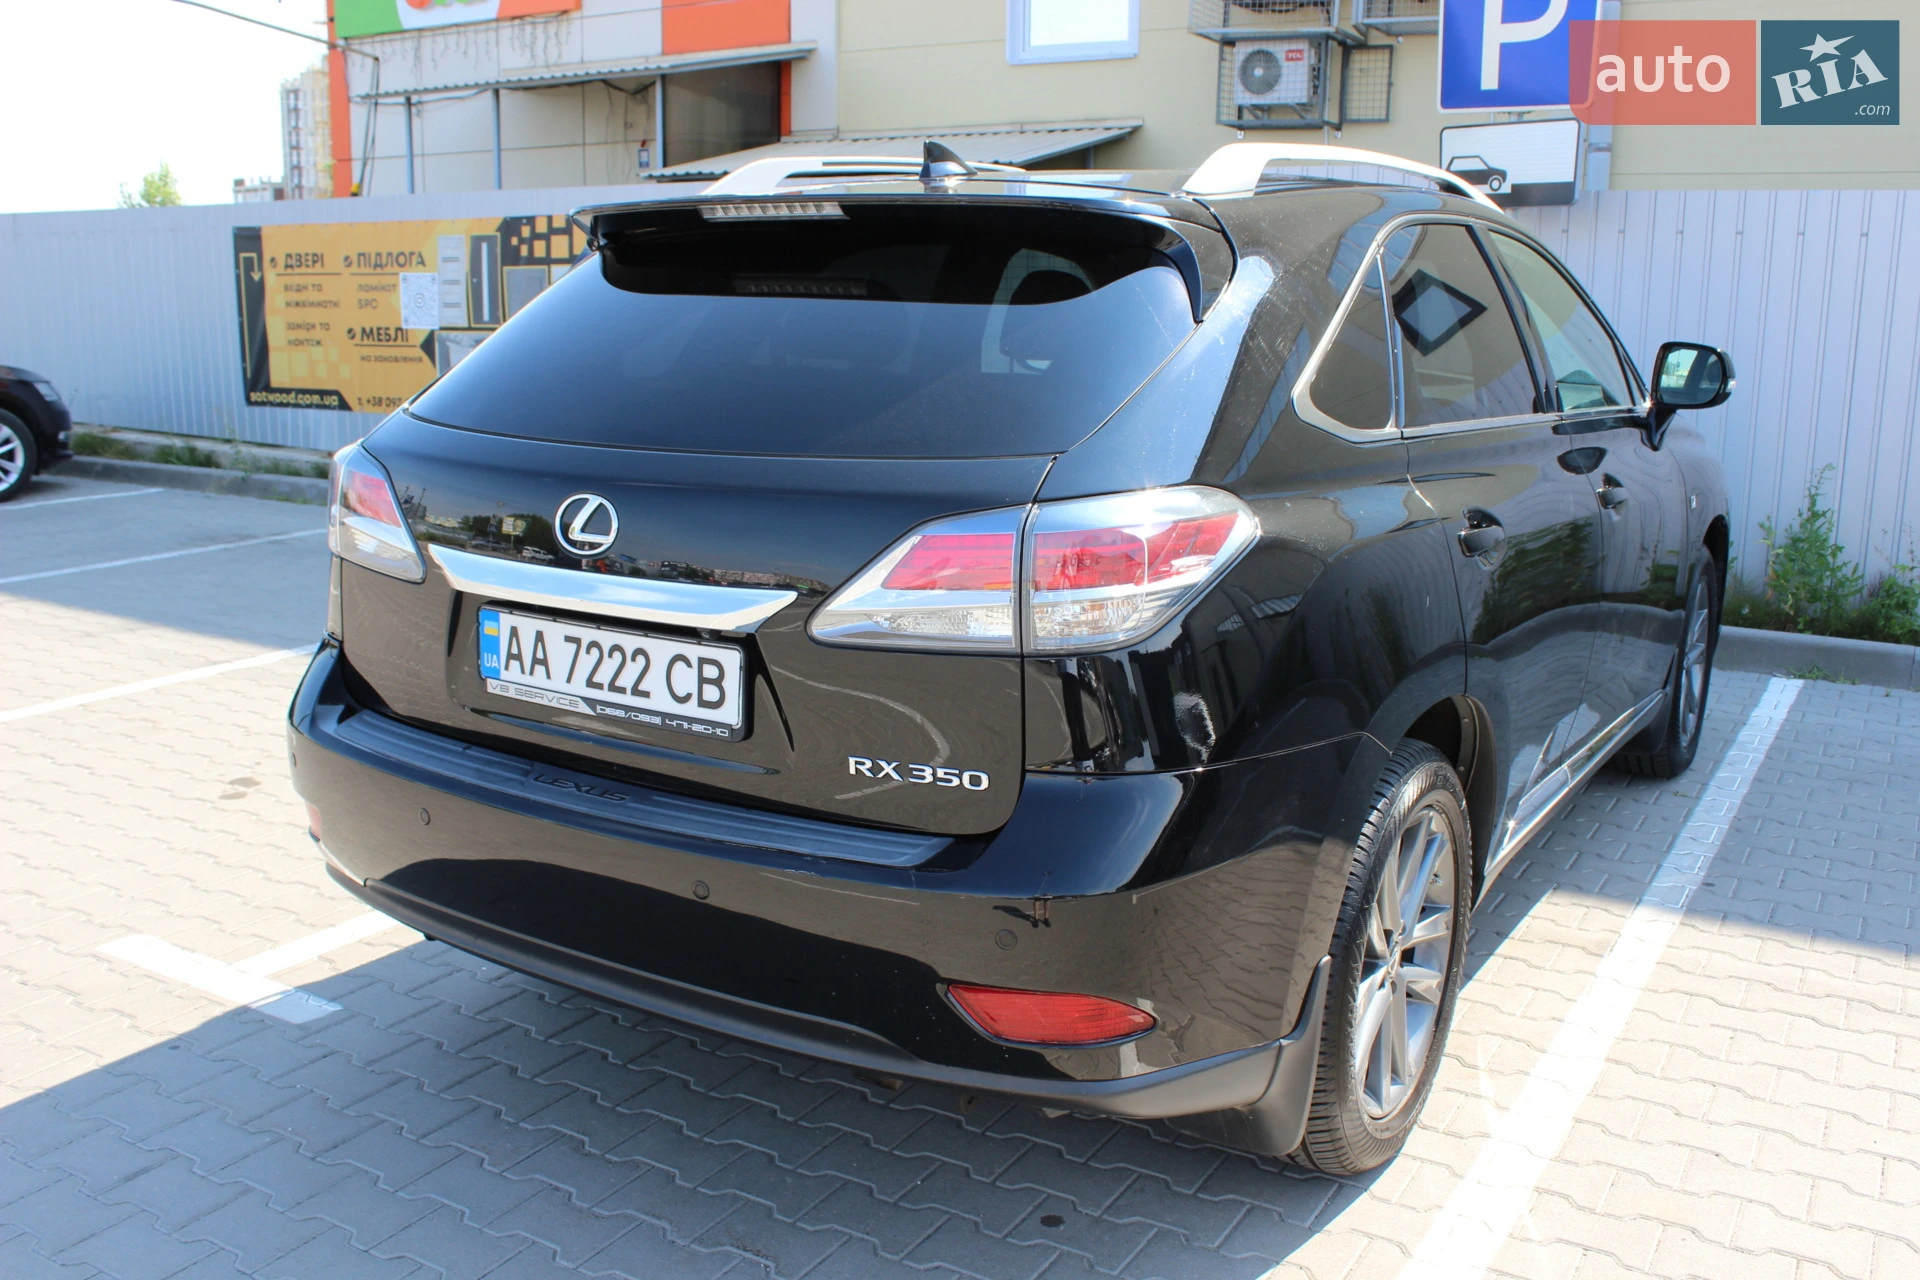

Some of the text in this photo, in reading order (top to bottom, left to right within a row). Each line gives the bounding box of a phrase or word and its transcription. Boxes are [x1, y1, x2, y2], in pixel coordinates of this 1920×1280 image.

[1480, 0, 1569, 90] P
[284, 252, 325, 271] ДВЕРІ
[356, 251, 426, 271] ПІДЛОГА
[360, 326, 409, 343] МЕБЛІ
[249, 390, 339, 406] sotwood.com.ua
[484, 652, 499, 669] UA
[504, 625, 726, 710] AA 7222 CB
[514, 687, 580, 709] SERVICE
[848, 756, 990, 791] RX 350
[532, 774, 631, 802] LEXUS
